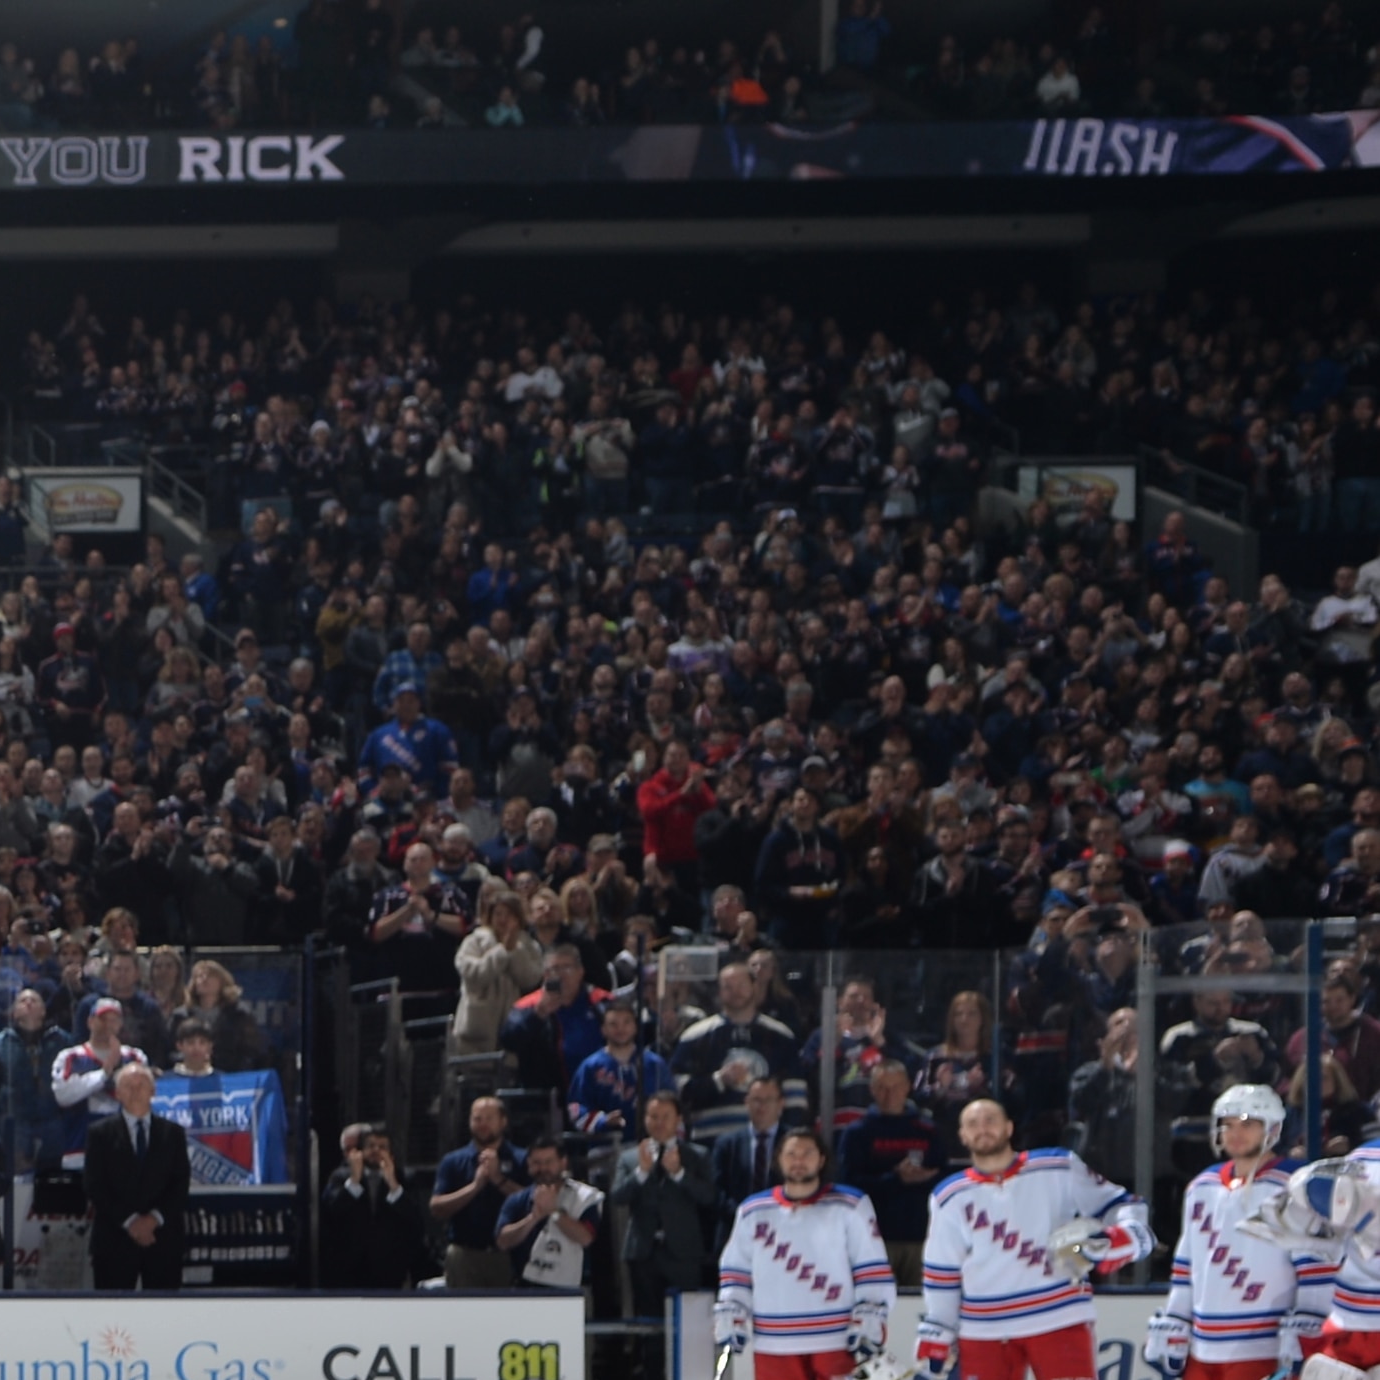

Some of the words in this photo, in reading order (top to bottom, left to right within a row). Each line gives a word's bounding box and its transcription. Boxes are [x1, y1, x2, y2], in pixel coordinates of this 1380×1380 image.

[0, 137, 148, 185] YOU
[178, 136, 346, 182] RICK
[199, 1103, 249, 1128] YORK
